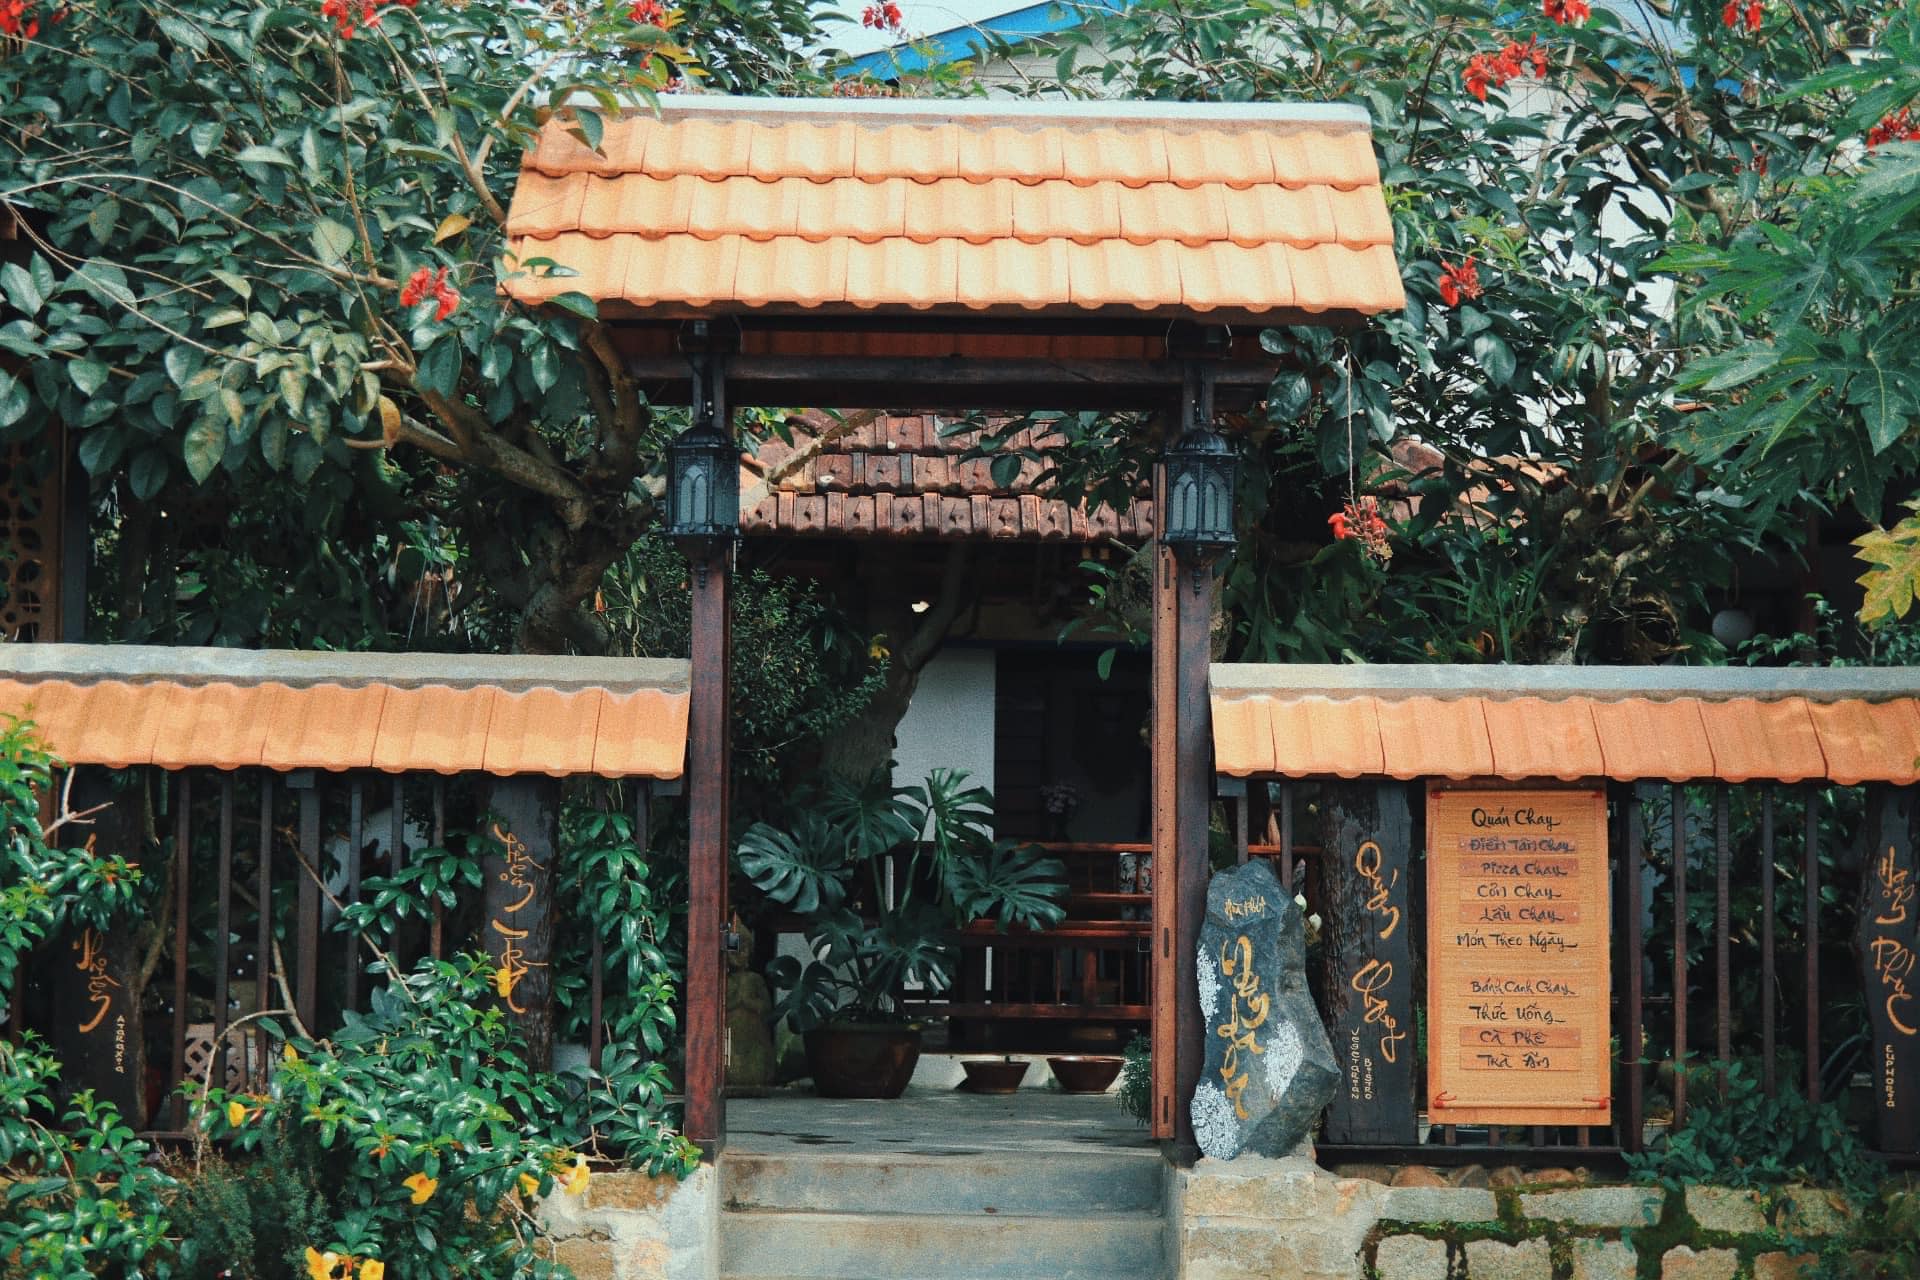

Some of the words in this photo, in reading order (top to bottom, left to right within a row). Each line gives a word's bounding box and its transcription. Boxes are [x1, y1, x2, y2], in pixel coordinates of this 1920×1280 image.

[1471, 807, 1510, 828] Quán
[1515, 808, 1561, 831] Chay
[1539, 838, 1575, 852] Chay
[1482, 862, 1520, 876] Pizza
[1524, 860, 1568, 876] Chay
[1355, 839, 1400, 940] Quán
[1514, 885, 1562, 900] Chay
[1519, 907, 1564, 922] Chay
[1456, 928, 1486, 947] Món
[1488, 932, 1523, 946] Theo
[1529, 931, 1577, 952] Ngày
[1470, 978, 1504, 994] Bánh
[1504, 980, 1533, 994] Canh
[1536, 980, 1575, 994] Chay
[1351, 958, 1406, 1064] Chay
[1479, 1029, 1506, 1044] Cà
[1512, 1031, 1546, 1046] Phê
